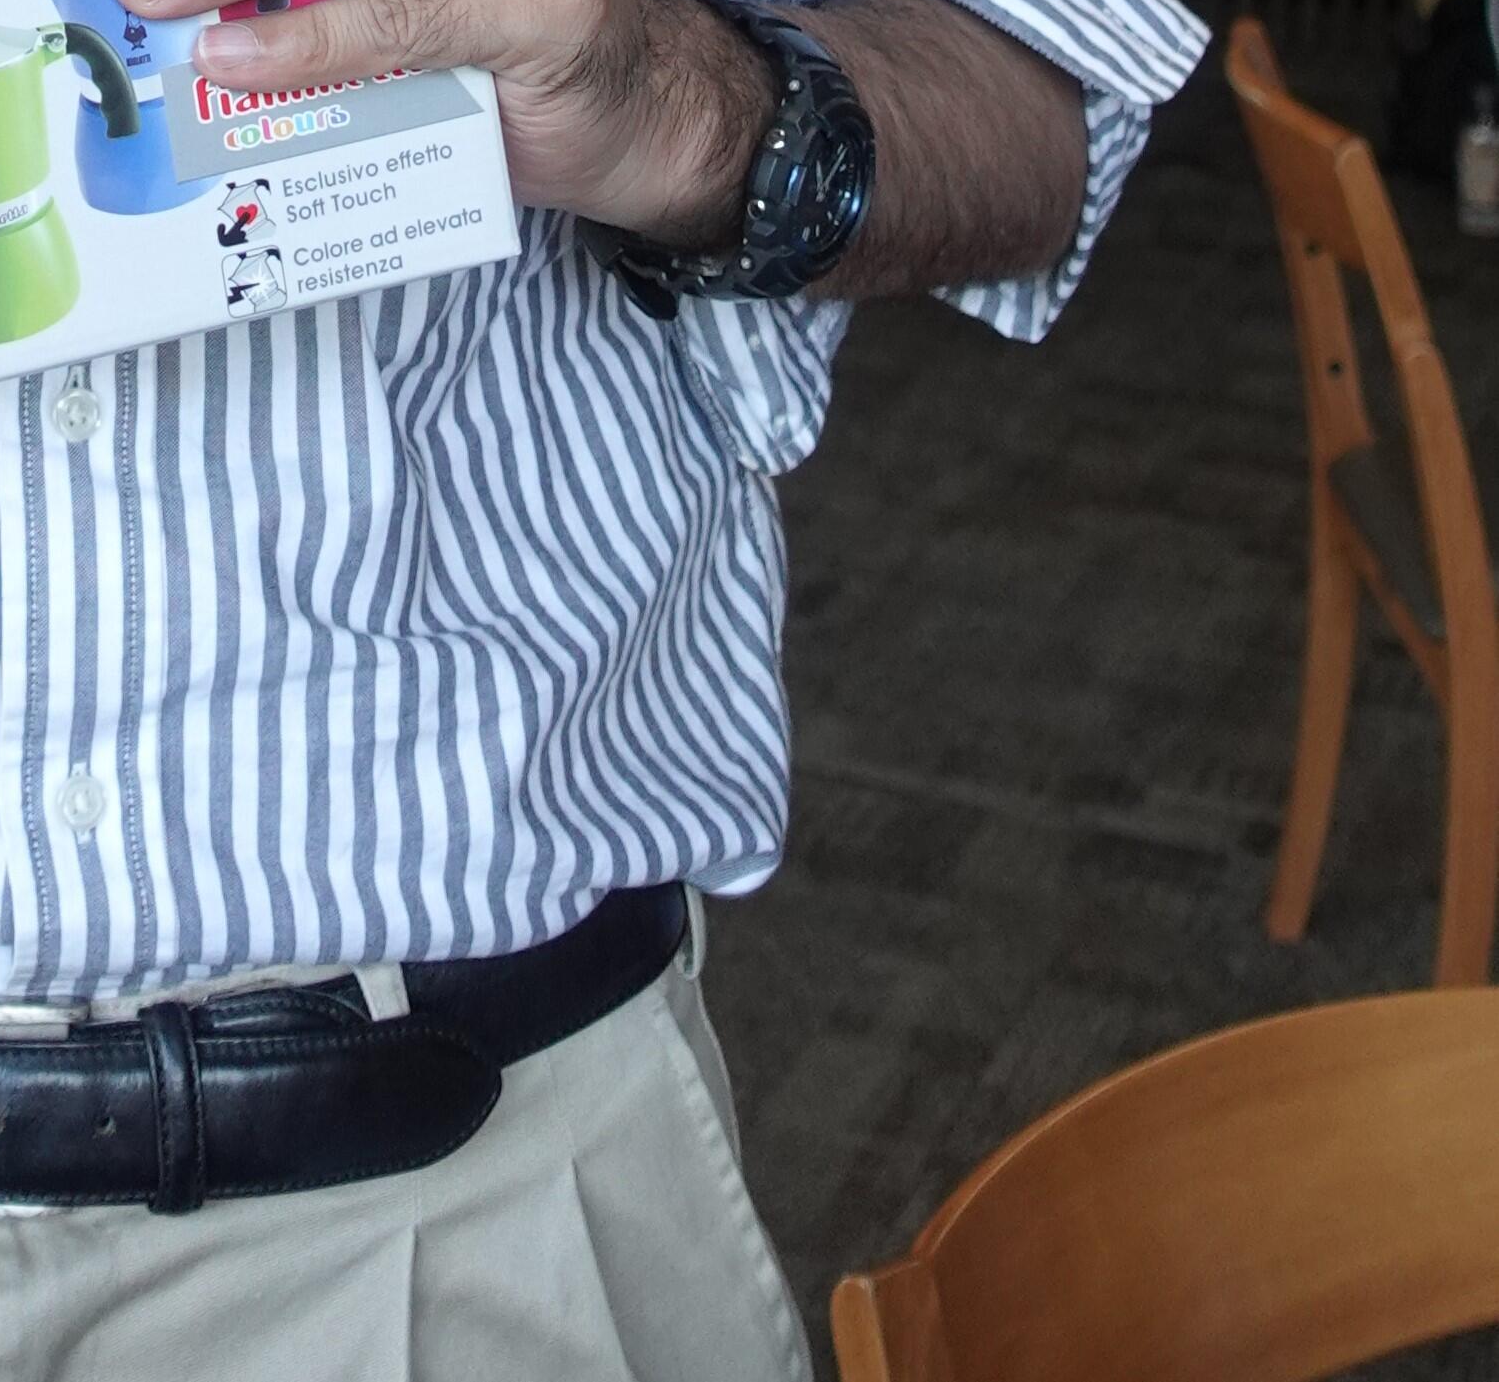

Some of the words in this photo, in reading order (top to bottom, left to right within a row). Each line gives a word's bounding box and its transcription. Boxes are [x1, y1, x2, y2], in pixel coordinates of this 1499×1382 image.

[224, 104, 350, 151] colours
[282, 159, 379, 197] Esclusivo
[386, 143, 453, 174] effetto
[286, 198, 326, 224] Soft
[330, 182, 396, 214] Touch
[293, 235, 364, 267] Colore
[370, 225, 399, 249] ad
[405, 207, 483, 241] elevata
[297, 253, 404, 294] resistenza
